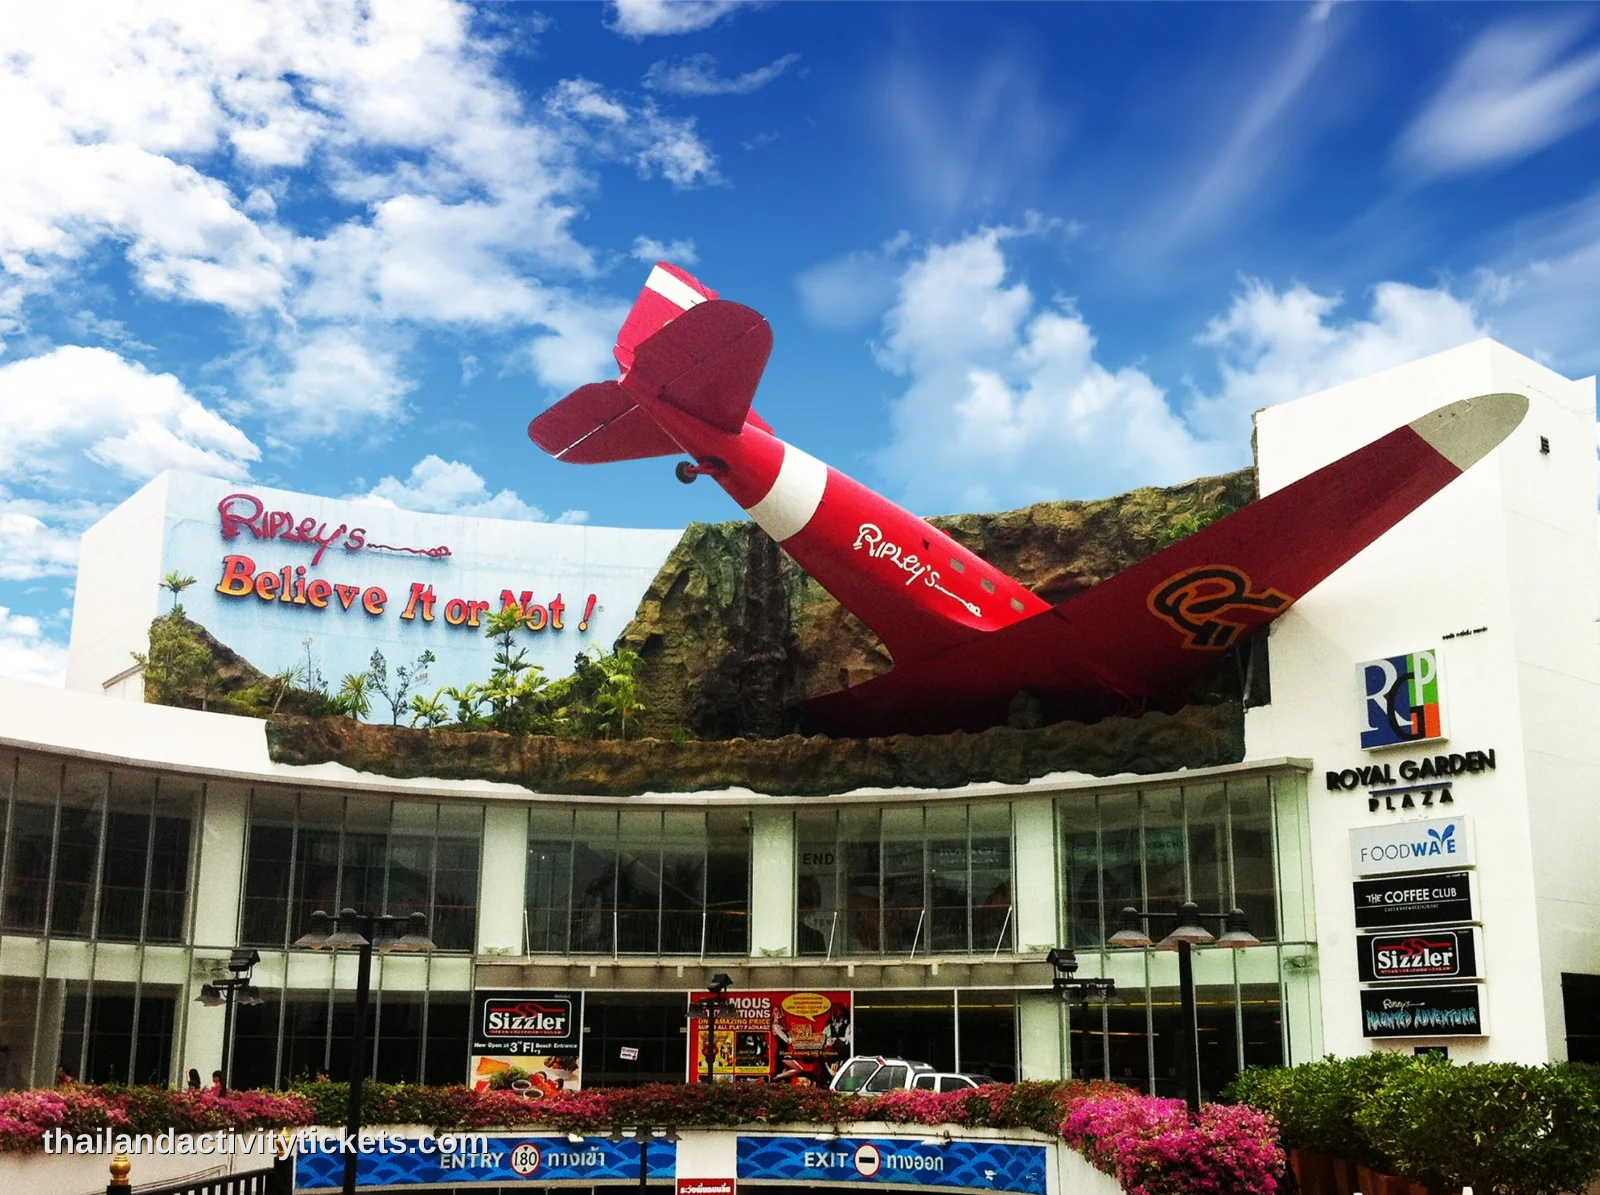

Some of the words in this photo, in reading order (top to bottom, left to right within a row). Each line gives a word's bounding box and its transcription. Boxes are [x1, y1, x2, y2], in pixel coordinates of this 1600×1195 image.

[216, 555, 388, 615] Believe
[401, 582, 437, 622] It
[445, 597, 489, 627] or
[1326, 764, 1396, 790] ROYAL
[1399, 749, 1496, 780] GARDEN
[1368, 788, 1454, 812] PLAZA
[1366, 894, 1382, 904] THE
[1385, 888, 1429, 903] COFFEE
[1432, 888, 1457, 898] CLUB
[1377, 949, 1453, 969] Sizzler
[489, 1012, 566, 1030] Sizzler
[1366, 1009, 1412, 1031] HAUNTED
[1414, 1007, 1477, 1028] ADVENTURE
[440, 1152, 504, 1169] ENTRY
[548, 1146, 605, 1167] ทางเข้า
[804, 1152, 848, 1168] EXIT
[887, 1154, 944, 1171] ทางออก
